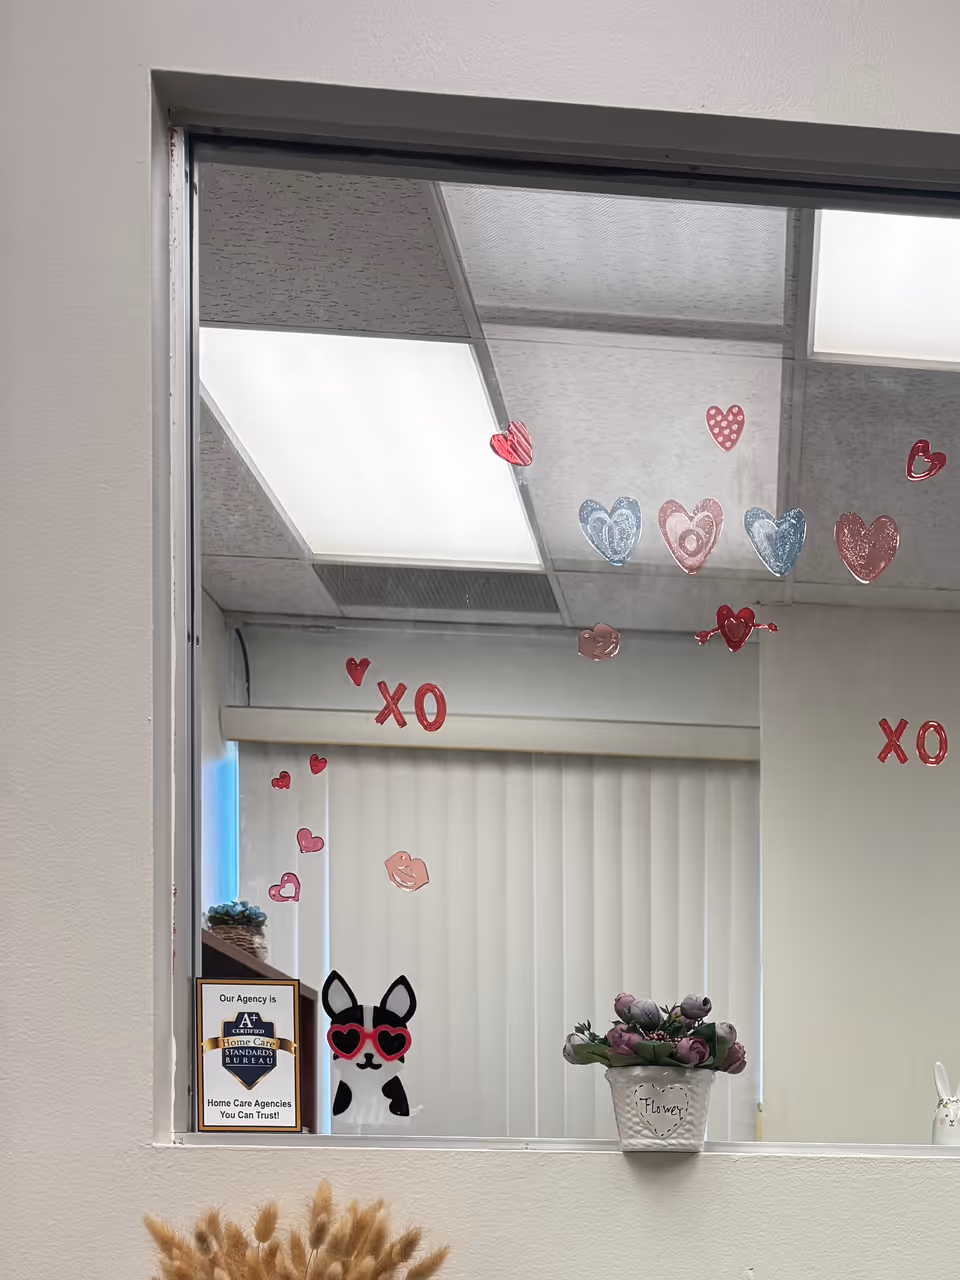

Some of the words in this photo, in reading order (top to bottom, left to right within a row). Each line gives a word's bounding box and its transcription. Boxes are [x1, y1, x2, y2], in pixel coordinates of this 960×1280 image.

[375, 680, 447, 732] XO
[877, 718, 948, 766] XO
[220, 994, 235, 1002] Our
[236, 995, 268, 1004] Agency
[269, 995, 277, 1003] is
[239, 1013, 258, 1028] A+
[222, 1039, 250, 1048] Home
[253, 1038, 275, 1048] Care
[208, 1099, 232, 1107] Home
[233, 1099, 252, 1107] Care
[254, 1100, 292, 1109] Agencies
[220, 1111, 236, 1119] You
[238, 1111, 254, 1119] Can
